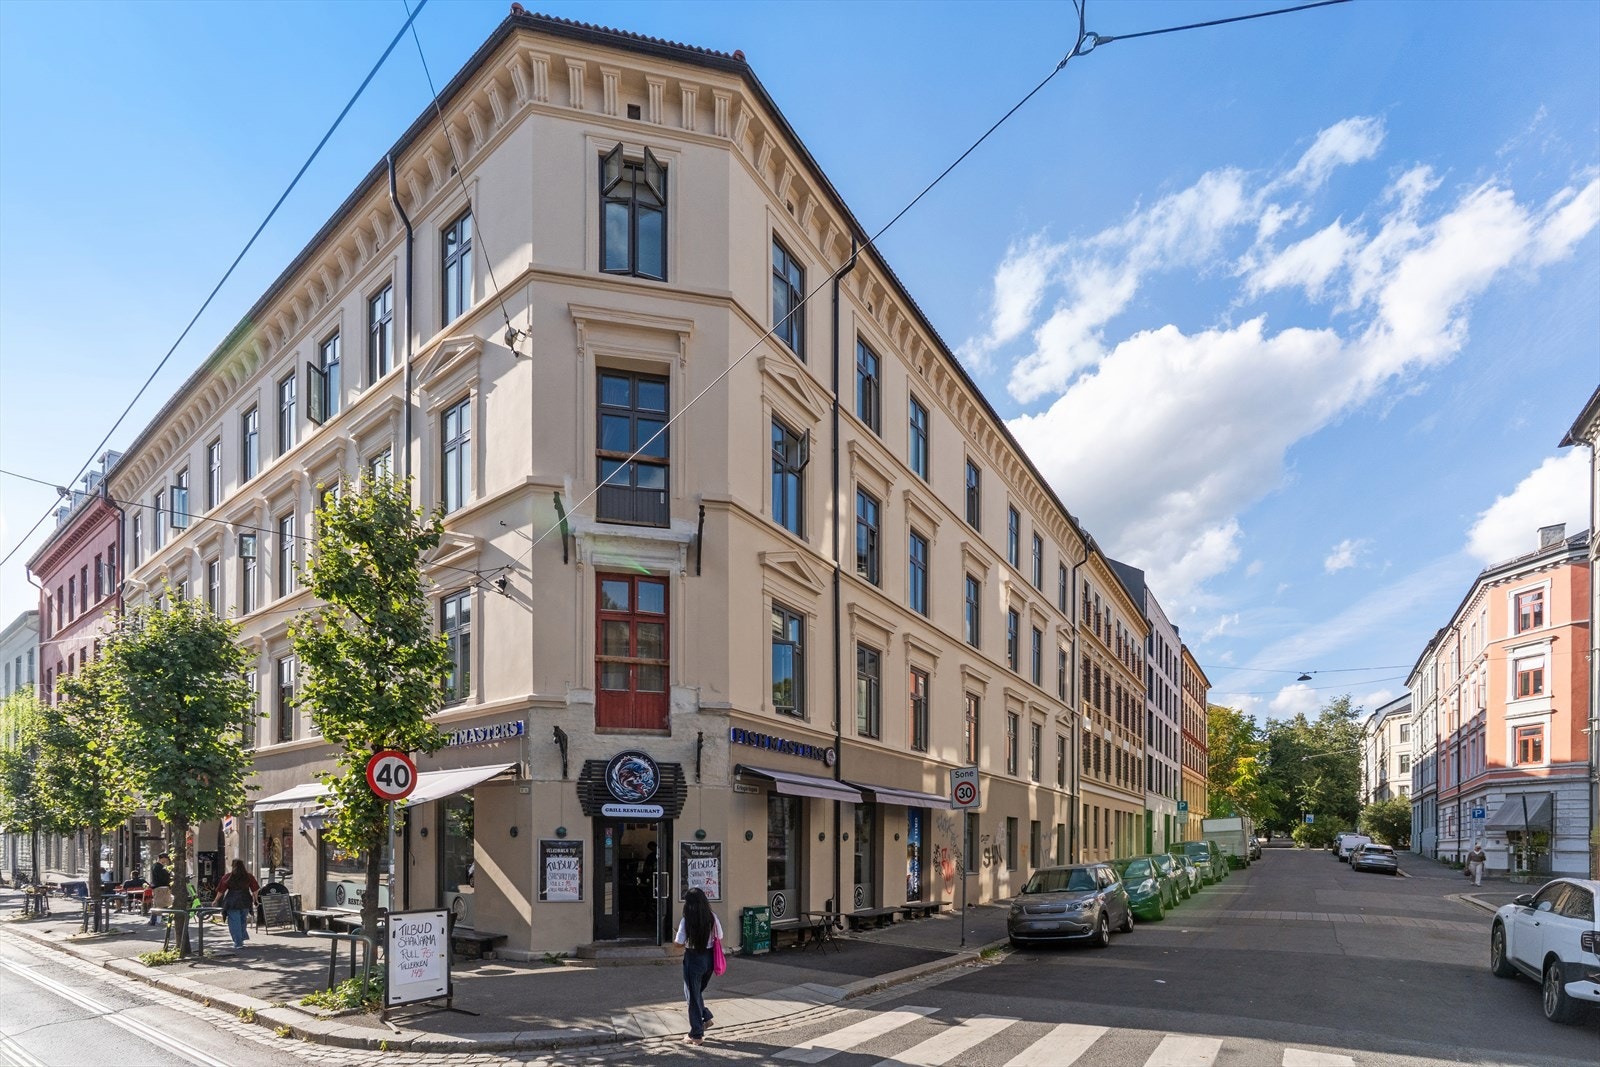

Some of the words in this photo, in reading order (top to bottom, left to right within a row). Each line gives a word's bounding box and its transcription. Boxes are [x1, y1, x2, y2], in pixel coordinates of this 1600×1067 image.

[732, 727, 825, 761] FISHMASTERS
[376, 763, 410, 788] 40
[954, 770, 974, 779] Sone
[958, 787, 973, 799] 30
[1475, 810, 1482, 818] P
[398, 922, 433, 936] TILBUD
[397, 934, 437, 948] SHAWARMA
[399, 948, 420, 961] RULL
